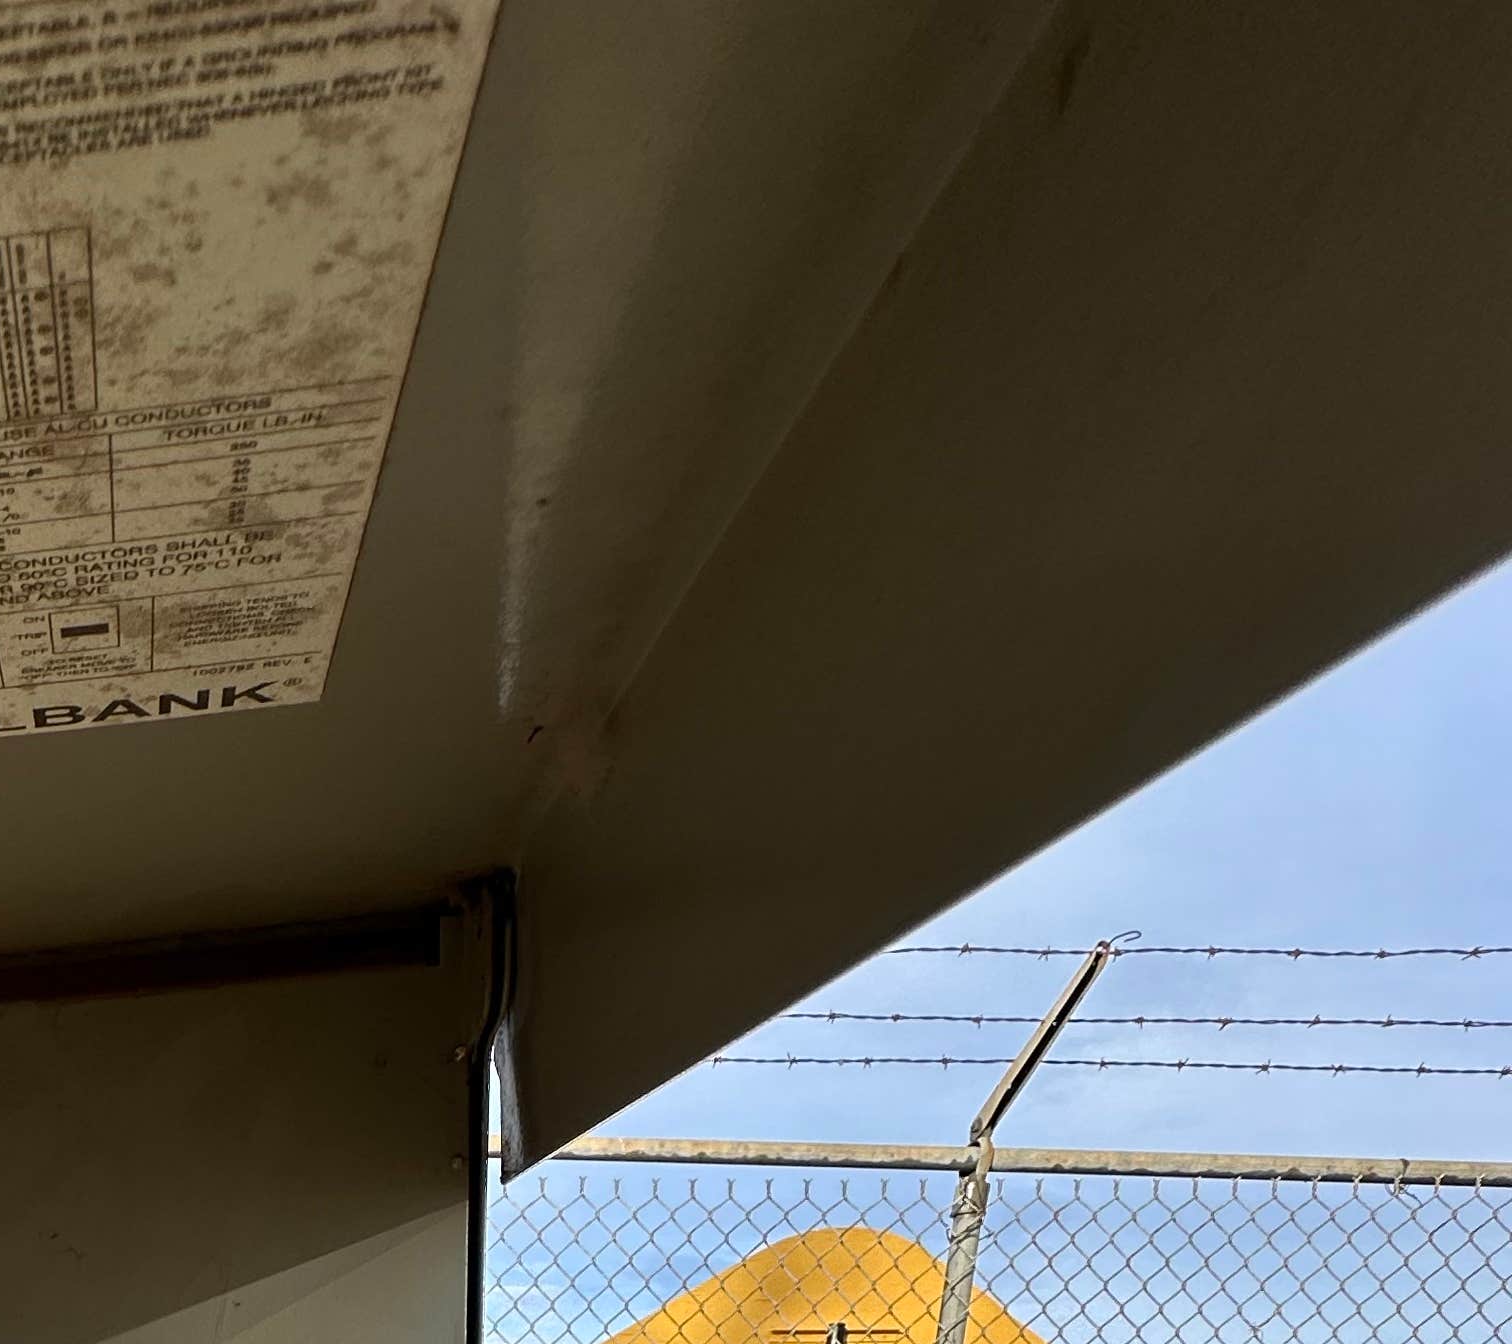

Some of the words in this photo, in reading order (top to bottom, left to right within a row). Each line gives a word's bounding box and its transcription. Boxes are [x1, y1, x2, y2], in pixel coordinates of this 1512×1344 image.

[116, 397, 271, 426] CONDUCTORS
[167, 420, 254, 440] TORQUE
[167, 534, 231, 551] SHALL
[75, 557, 154, 574] RATING
[163, 550, 207, 564] FOR
[217, 543, 253, 557] 110
[76, 571, 139, 586] SIZED
[147, 566, 175, 577] TO
[237, 553, 281, 566] FOR
[23, 615, 45, 623] ON
[12, 631, 47, 640] TRIP
[21, 647, 48, 656] OFF
